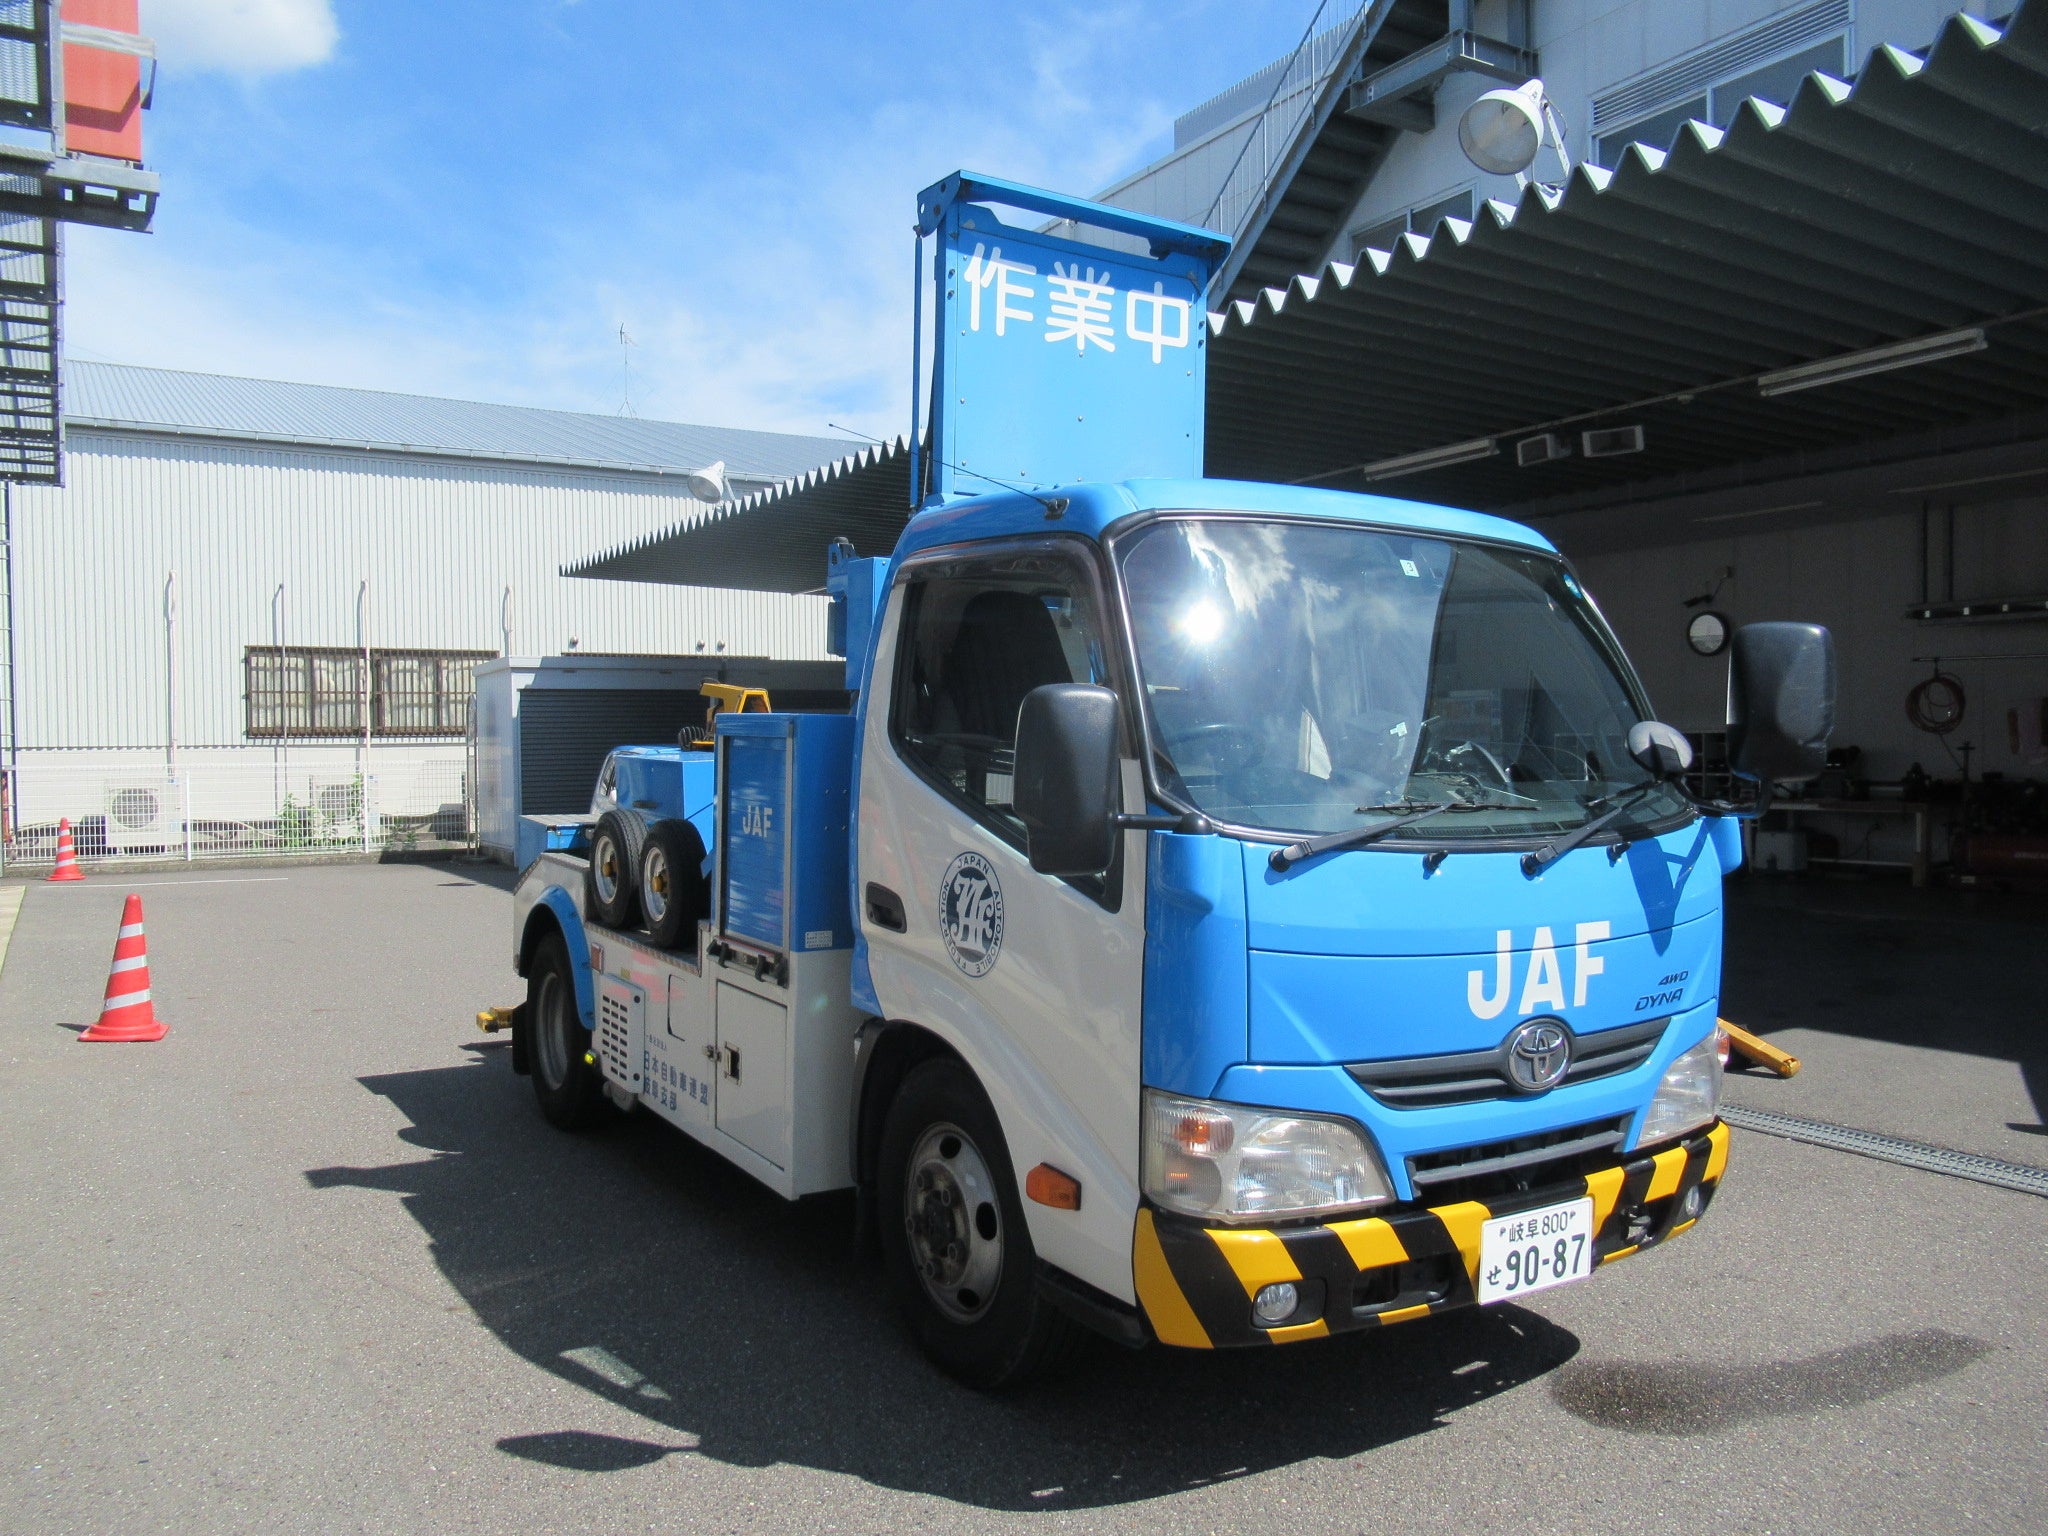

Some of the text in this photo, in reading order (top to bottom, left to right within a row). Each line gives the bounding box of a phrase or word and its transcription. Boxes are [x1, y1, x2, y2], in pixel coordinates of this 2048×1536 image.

[963, 242, 1190, 364] 作業中
[742, 805, 773, 838] JAF
[957, 855, 990, 875] JAPAN
[940, 880, 967, 969] FEDERATION
[976, 890, 1002, 974] AUTOMOBILE
[1467, 920, 1610, 1019] JAF
[1657, 970, 1689, 986] 4WD
[1634, 987, 1684, 1012] DYNA
[1509, 1211, 1568, 1243] 岐阜 800
[1486, 1233, 1586, 1291] せ 90-87
